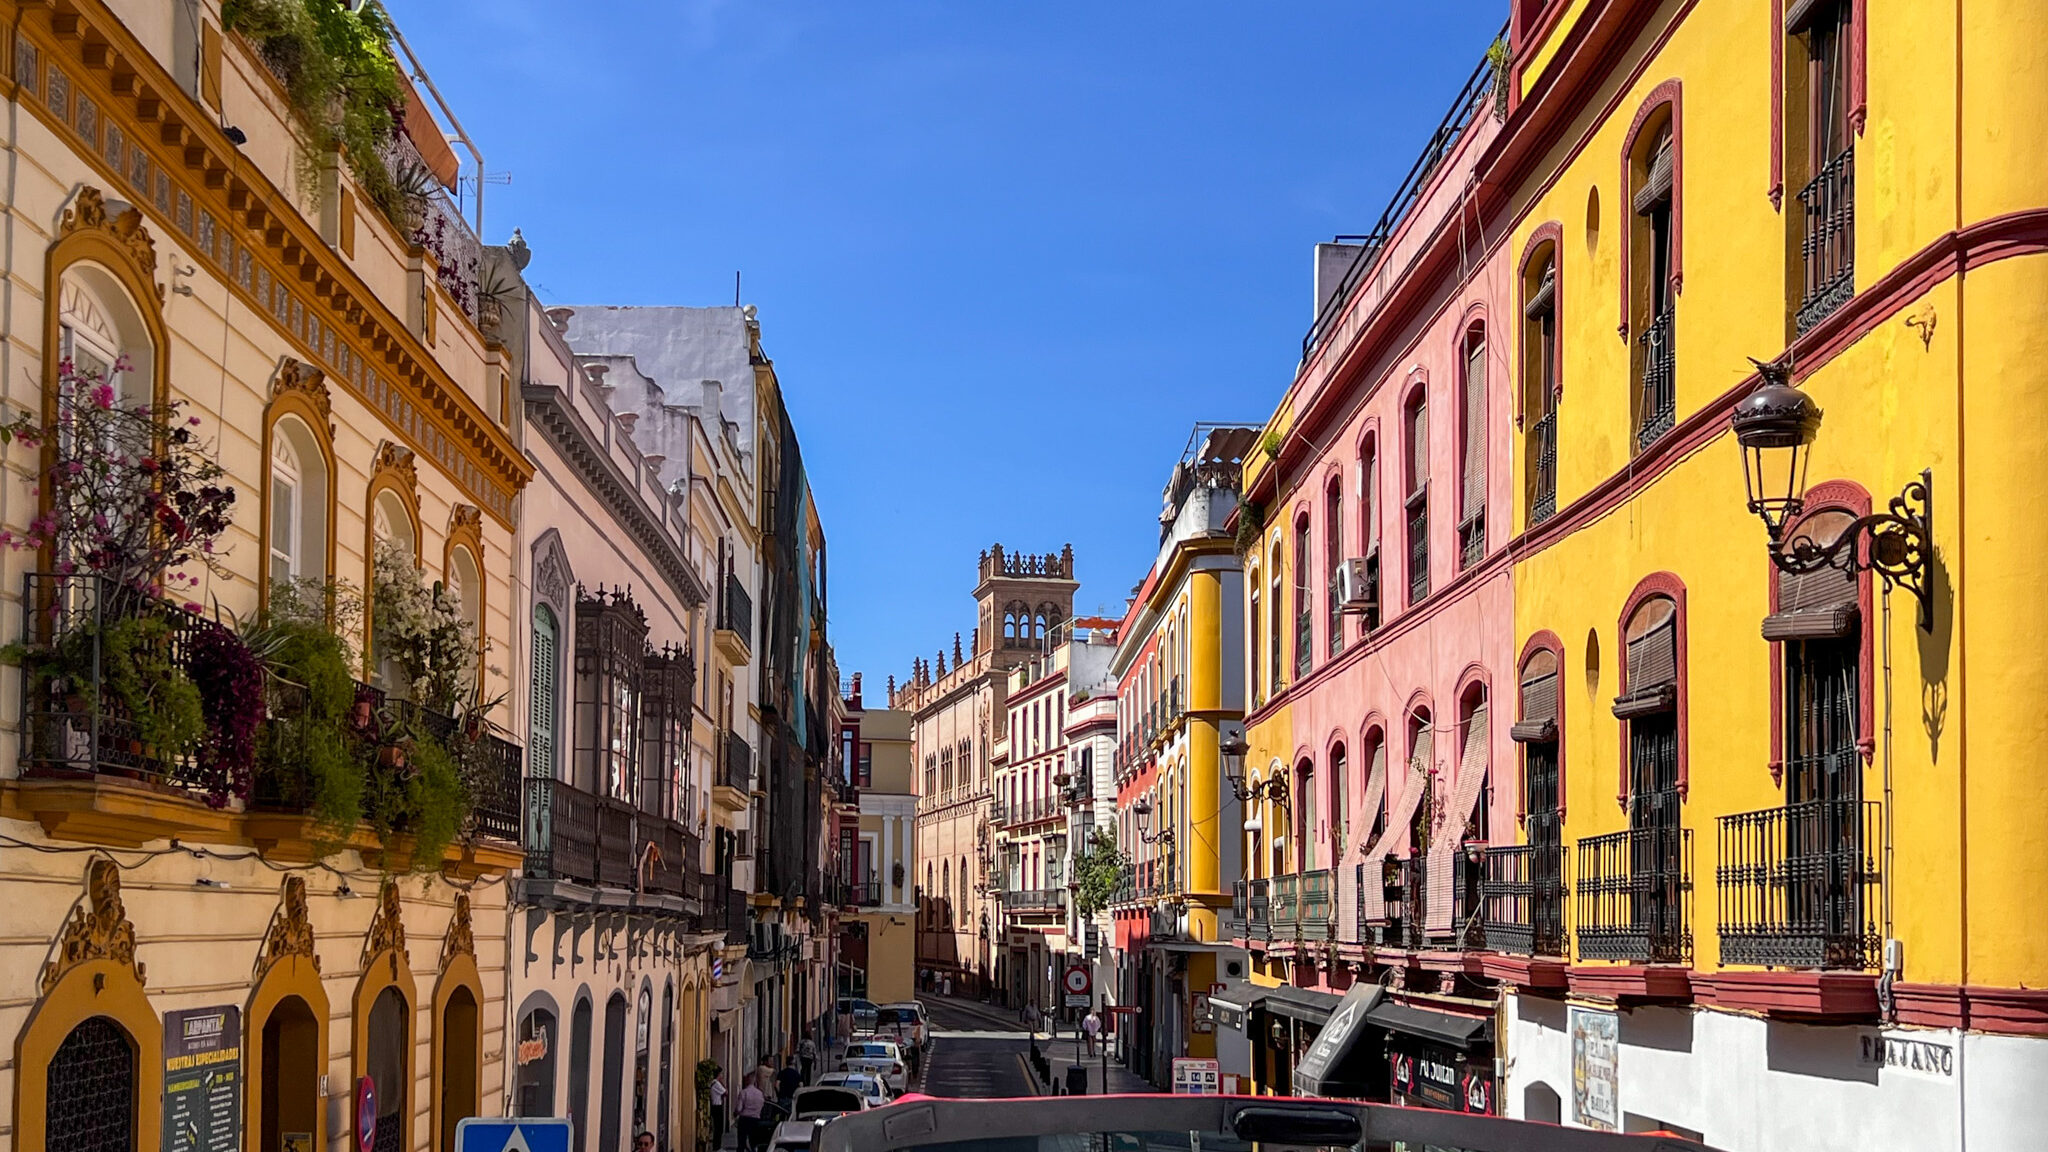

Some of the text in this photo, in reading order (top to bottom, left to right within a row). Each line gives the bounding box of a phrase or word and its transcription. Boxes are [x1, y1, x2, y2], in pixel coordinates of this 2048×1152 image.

[1860, 1035, 1953, 1076] TRAJANO
[1192, 1073, 1200, 1081] 14
[1205, 1073, 1215, 1081] A7
